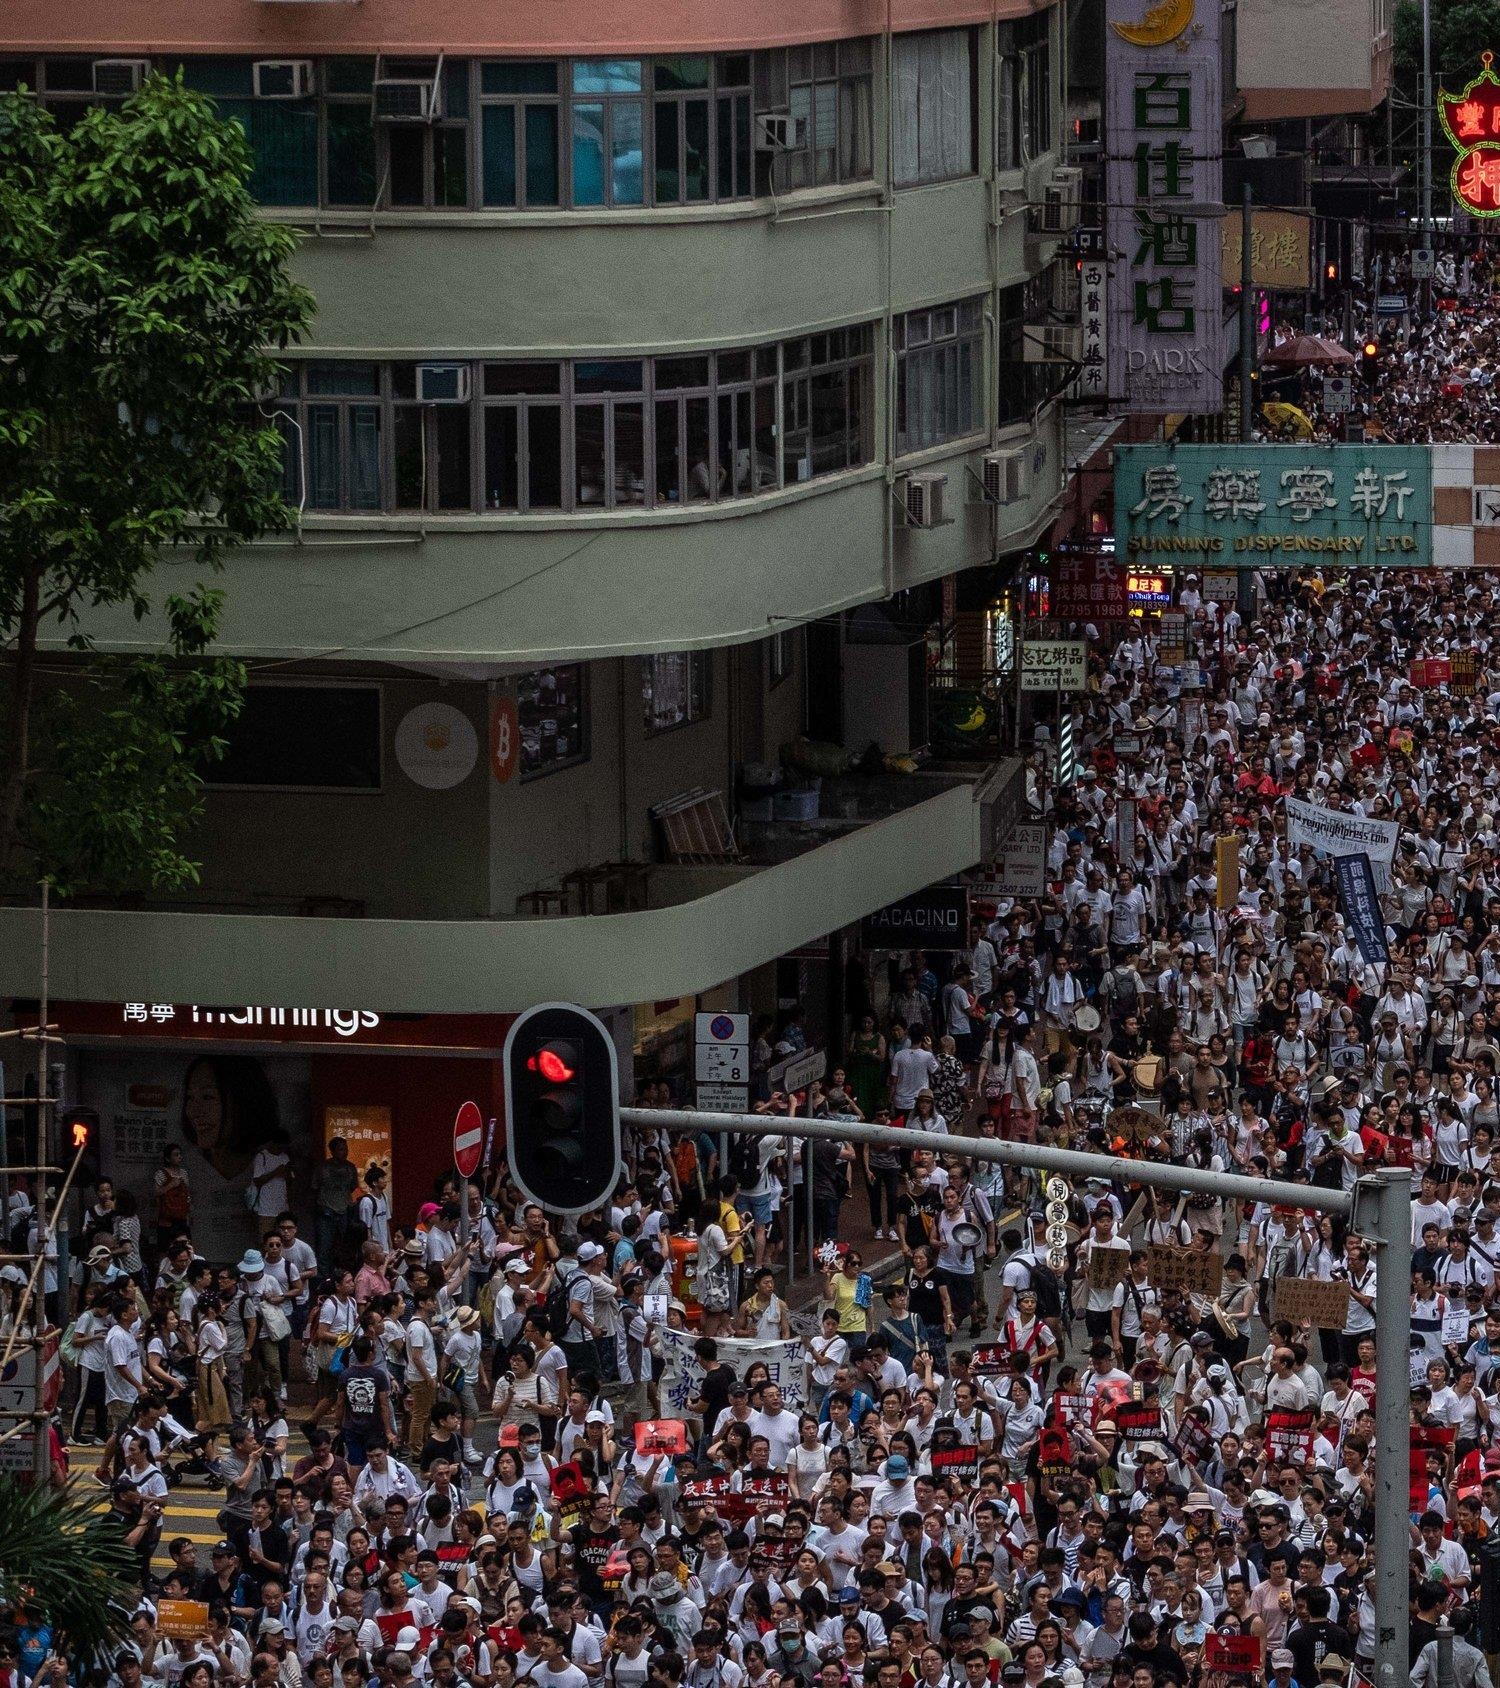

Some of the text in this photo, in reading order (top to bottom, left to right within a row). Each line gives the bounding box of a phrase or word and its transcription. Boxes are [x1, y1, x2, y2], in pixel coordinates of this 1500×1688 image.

[1132, 72, 1197, 335] 百佳酒店
[1126, 347, 1206, 374] PARK
[1129, 535, 1224, 552] SUNNING
[1234, 535, 1365, 553] DISPENSARY
[1059, 558, 1119, 580] 許氏
[1094, 604, 1123, 616] 1968
[1026, 845, 1040, 854] LTD
[999, 885, 1018, 893] 2507
[1019, 886, 1038, 895] 3737
[730, 1047, 739, 1060] 7
[731, 1067, 741, 1080] 8
[971, 1348, 1011, 1367] 反送中
[13, 1391, 24, 1405] 7
[683, 1479, 730, 1498] 反送中
[743, 1478, 789, 1496] 反送中
[752, 1541, 802, 1560] 反送中
